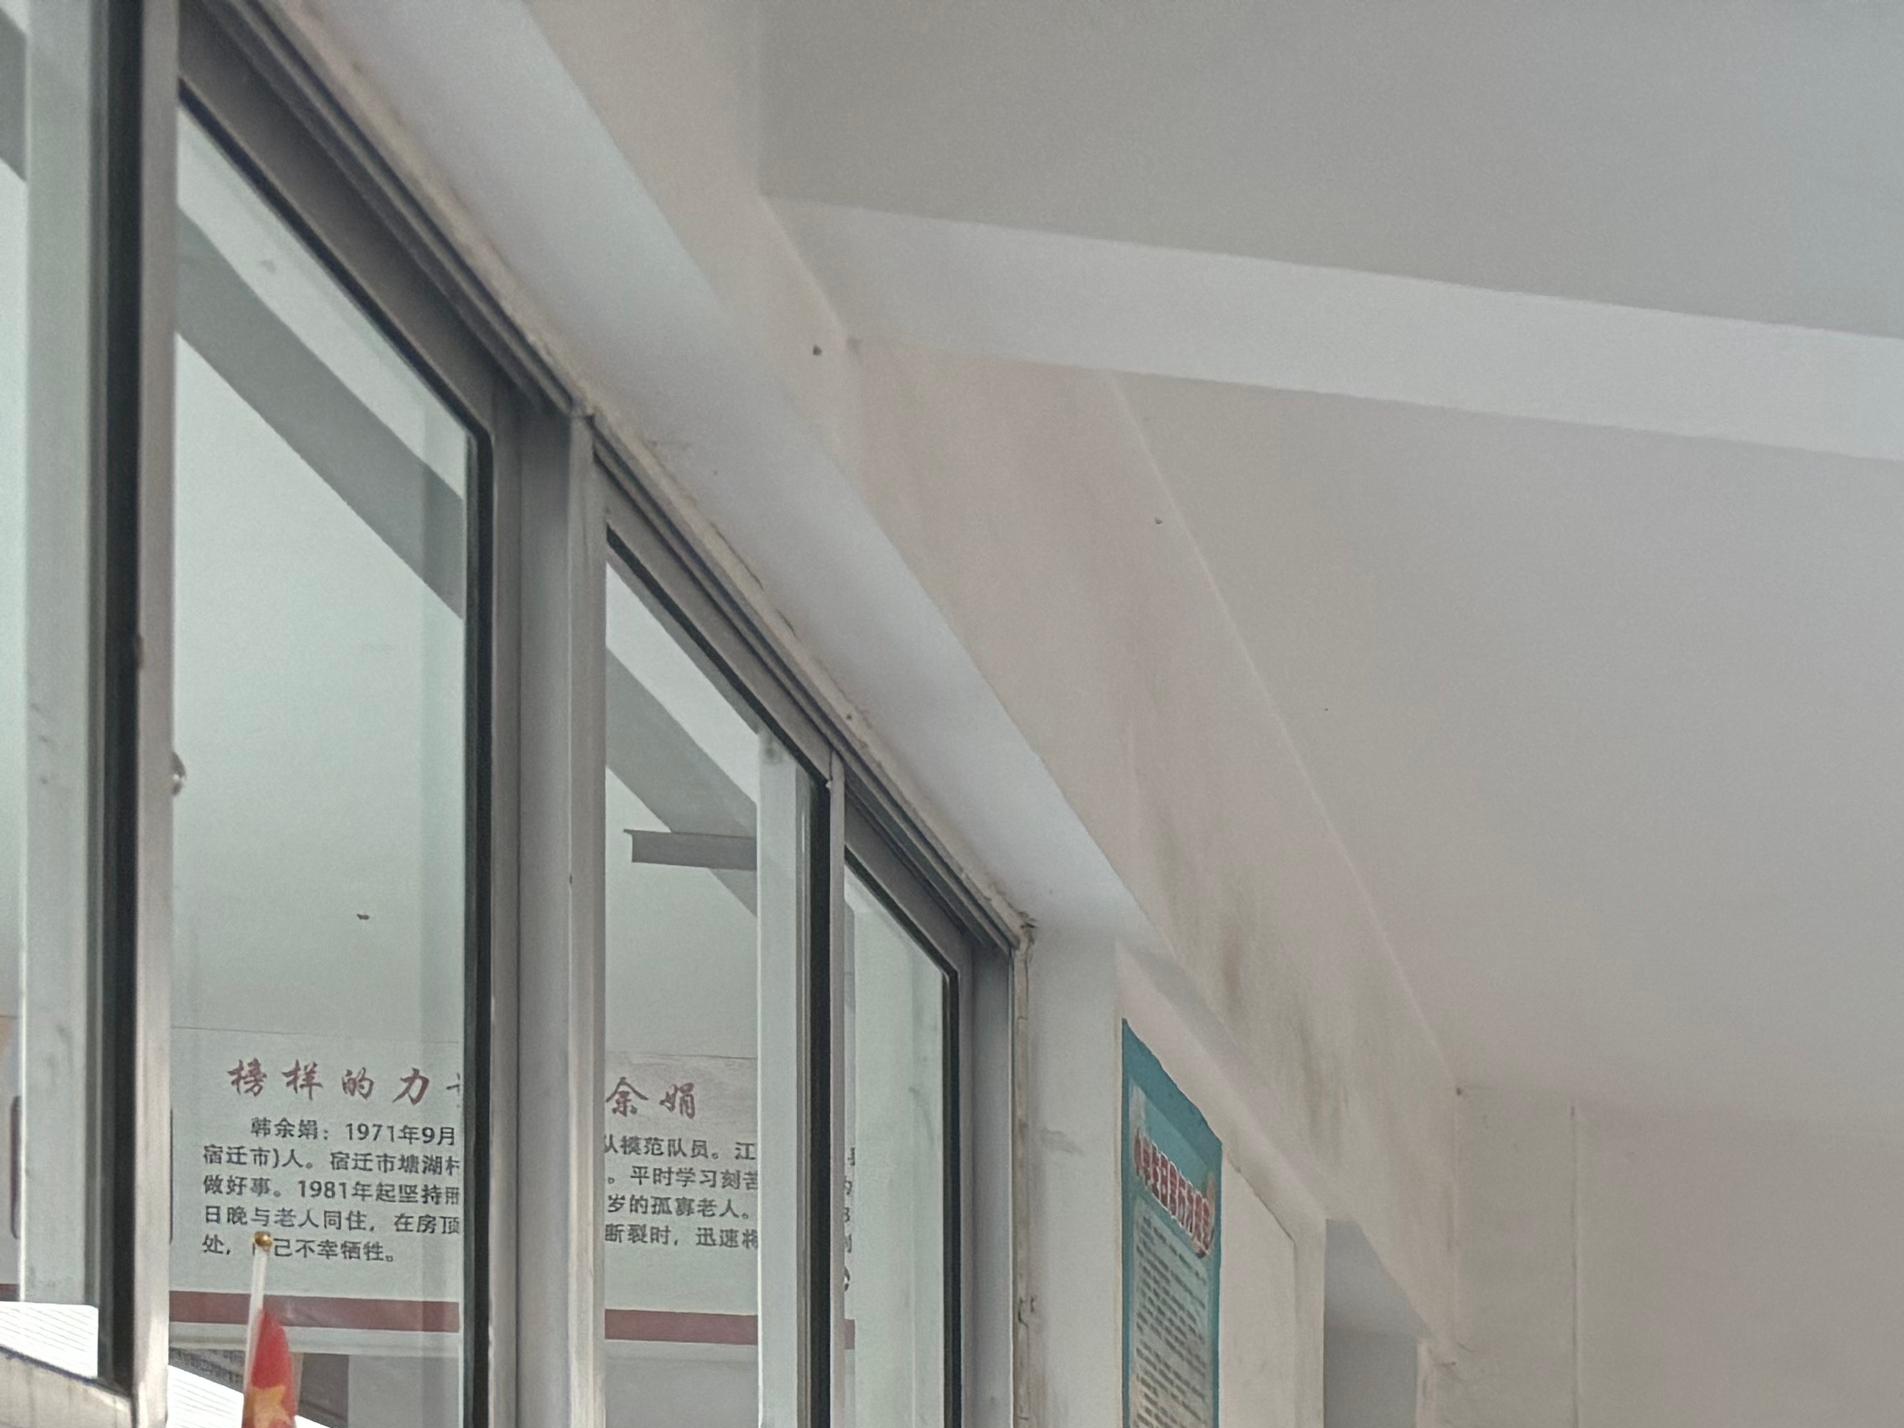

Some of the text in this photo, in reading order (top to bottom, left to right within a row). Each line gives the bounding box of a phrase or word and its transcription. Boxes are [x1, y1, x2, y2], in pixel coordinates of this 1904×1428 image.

[605, 1076, 697, 1120] 余娟
[201, 1234, 395, 1263] 处，己不幸牺牲。
